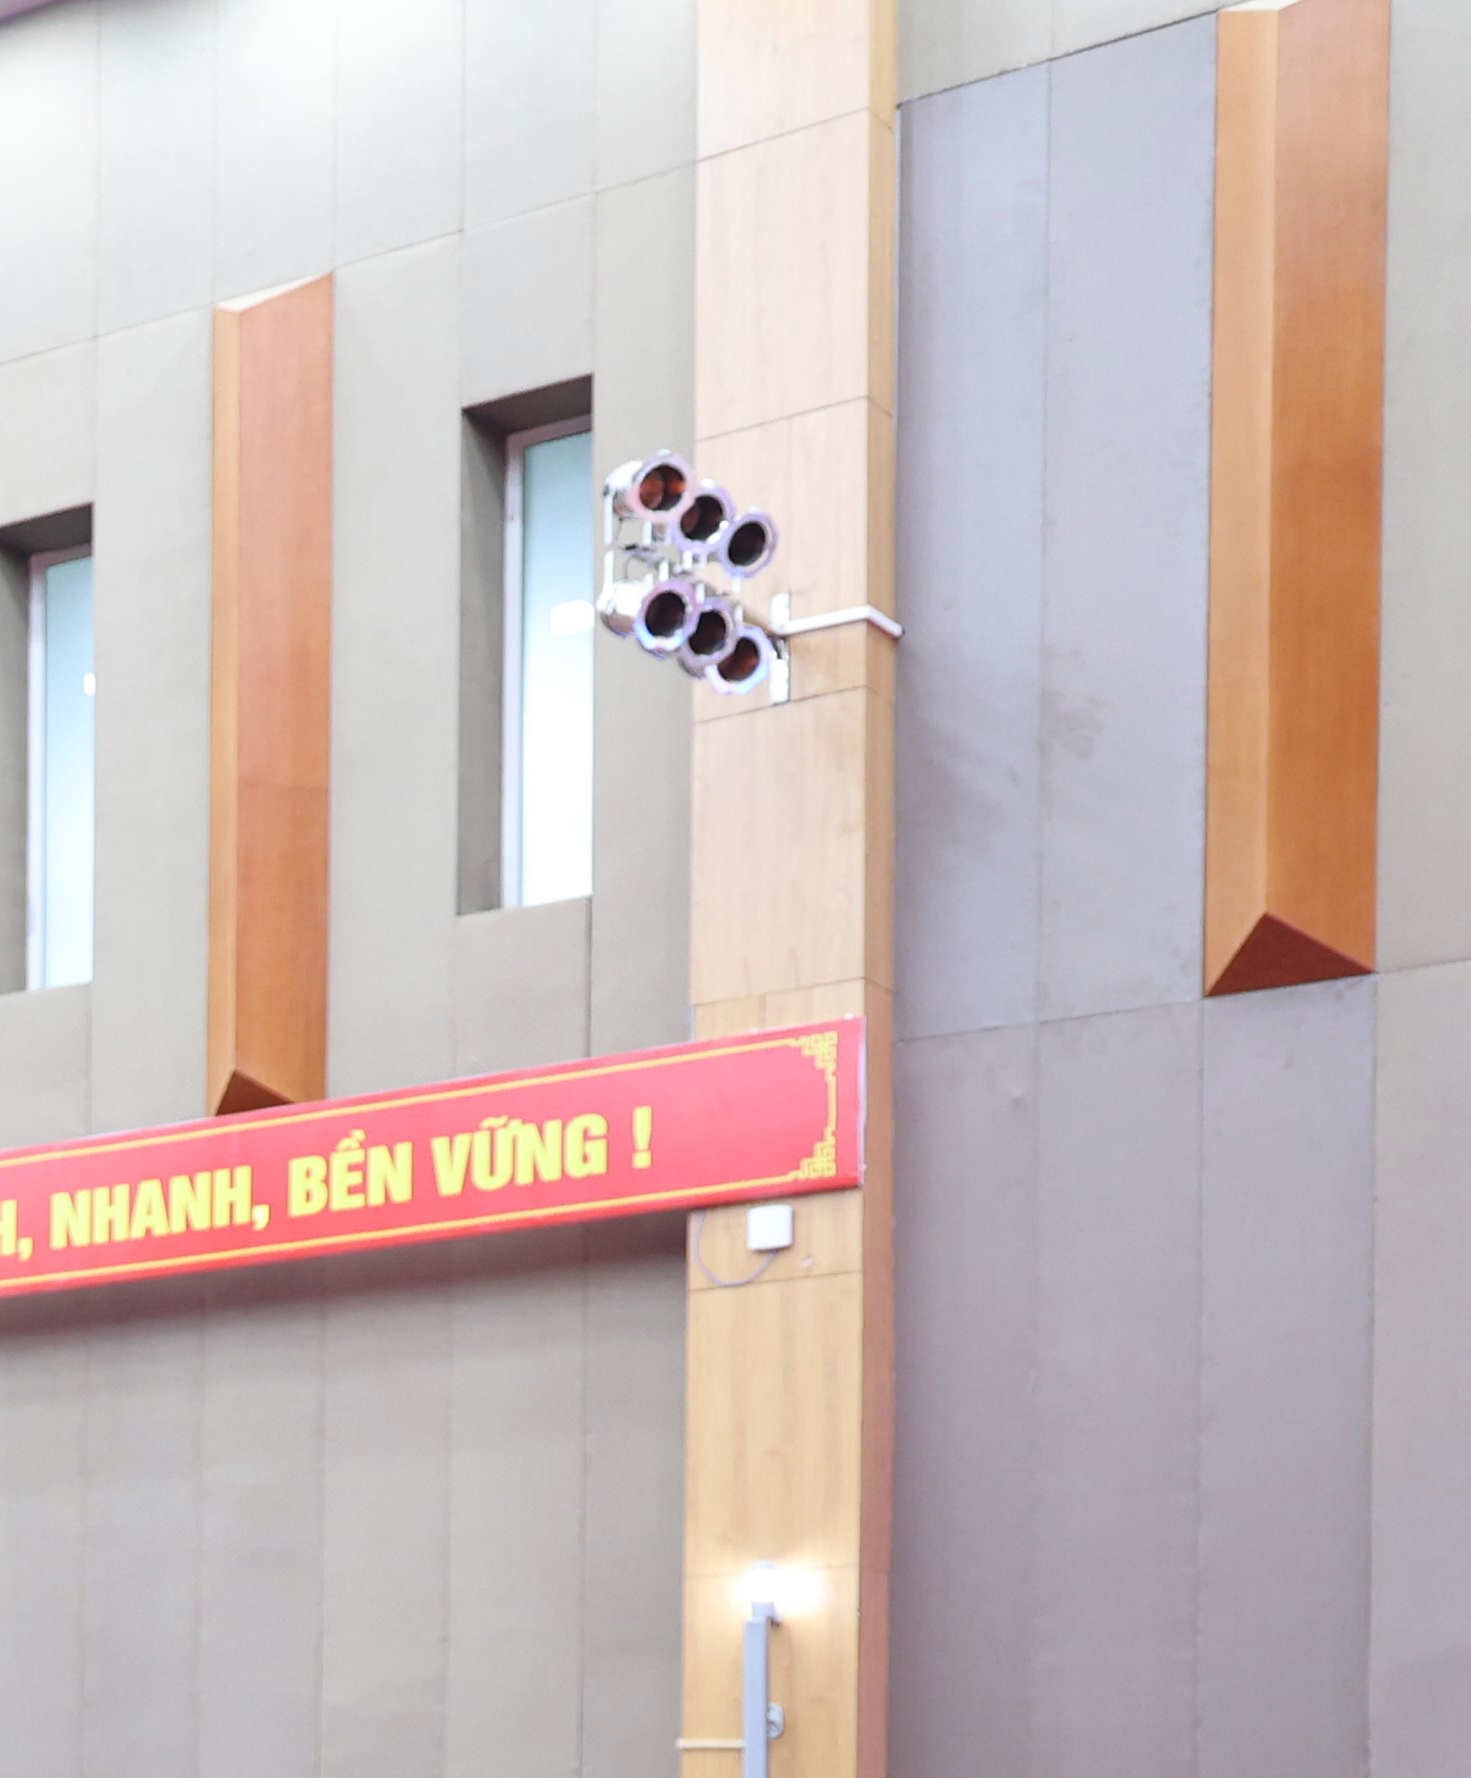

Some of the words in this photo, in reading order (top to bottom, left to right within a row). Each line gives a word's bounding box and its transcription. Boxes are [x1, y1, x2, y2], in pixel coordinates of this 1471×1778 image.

[49, 1165, 270, 1250] NHANH,
[288, 1129, 413, 1217] BỀN
[431, 1112, 609, 1197] VỮNG
[632, 1106, 654, 1169] !
